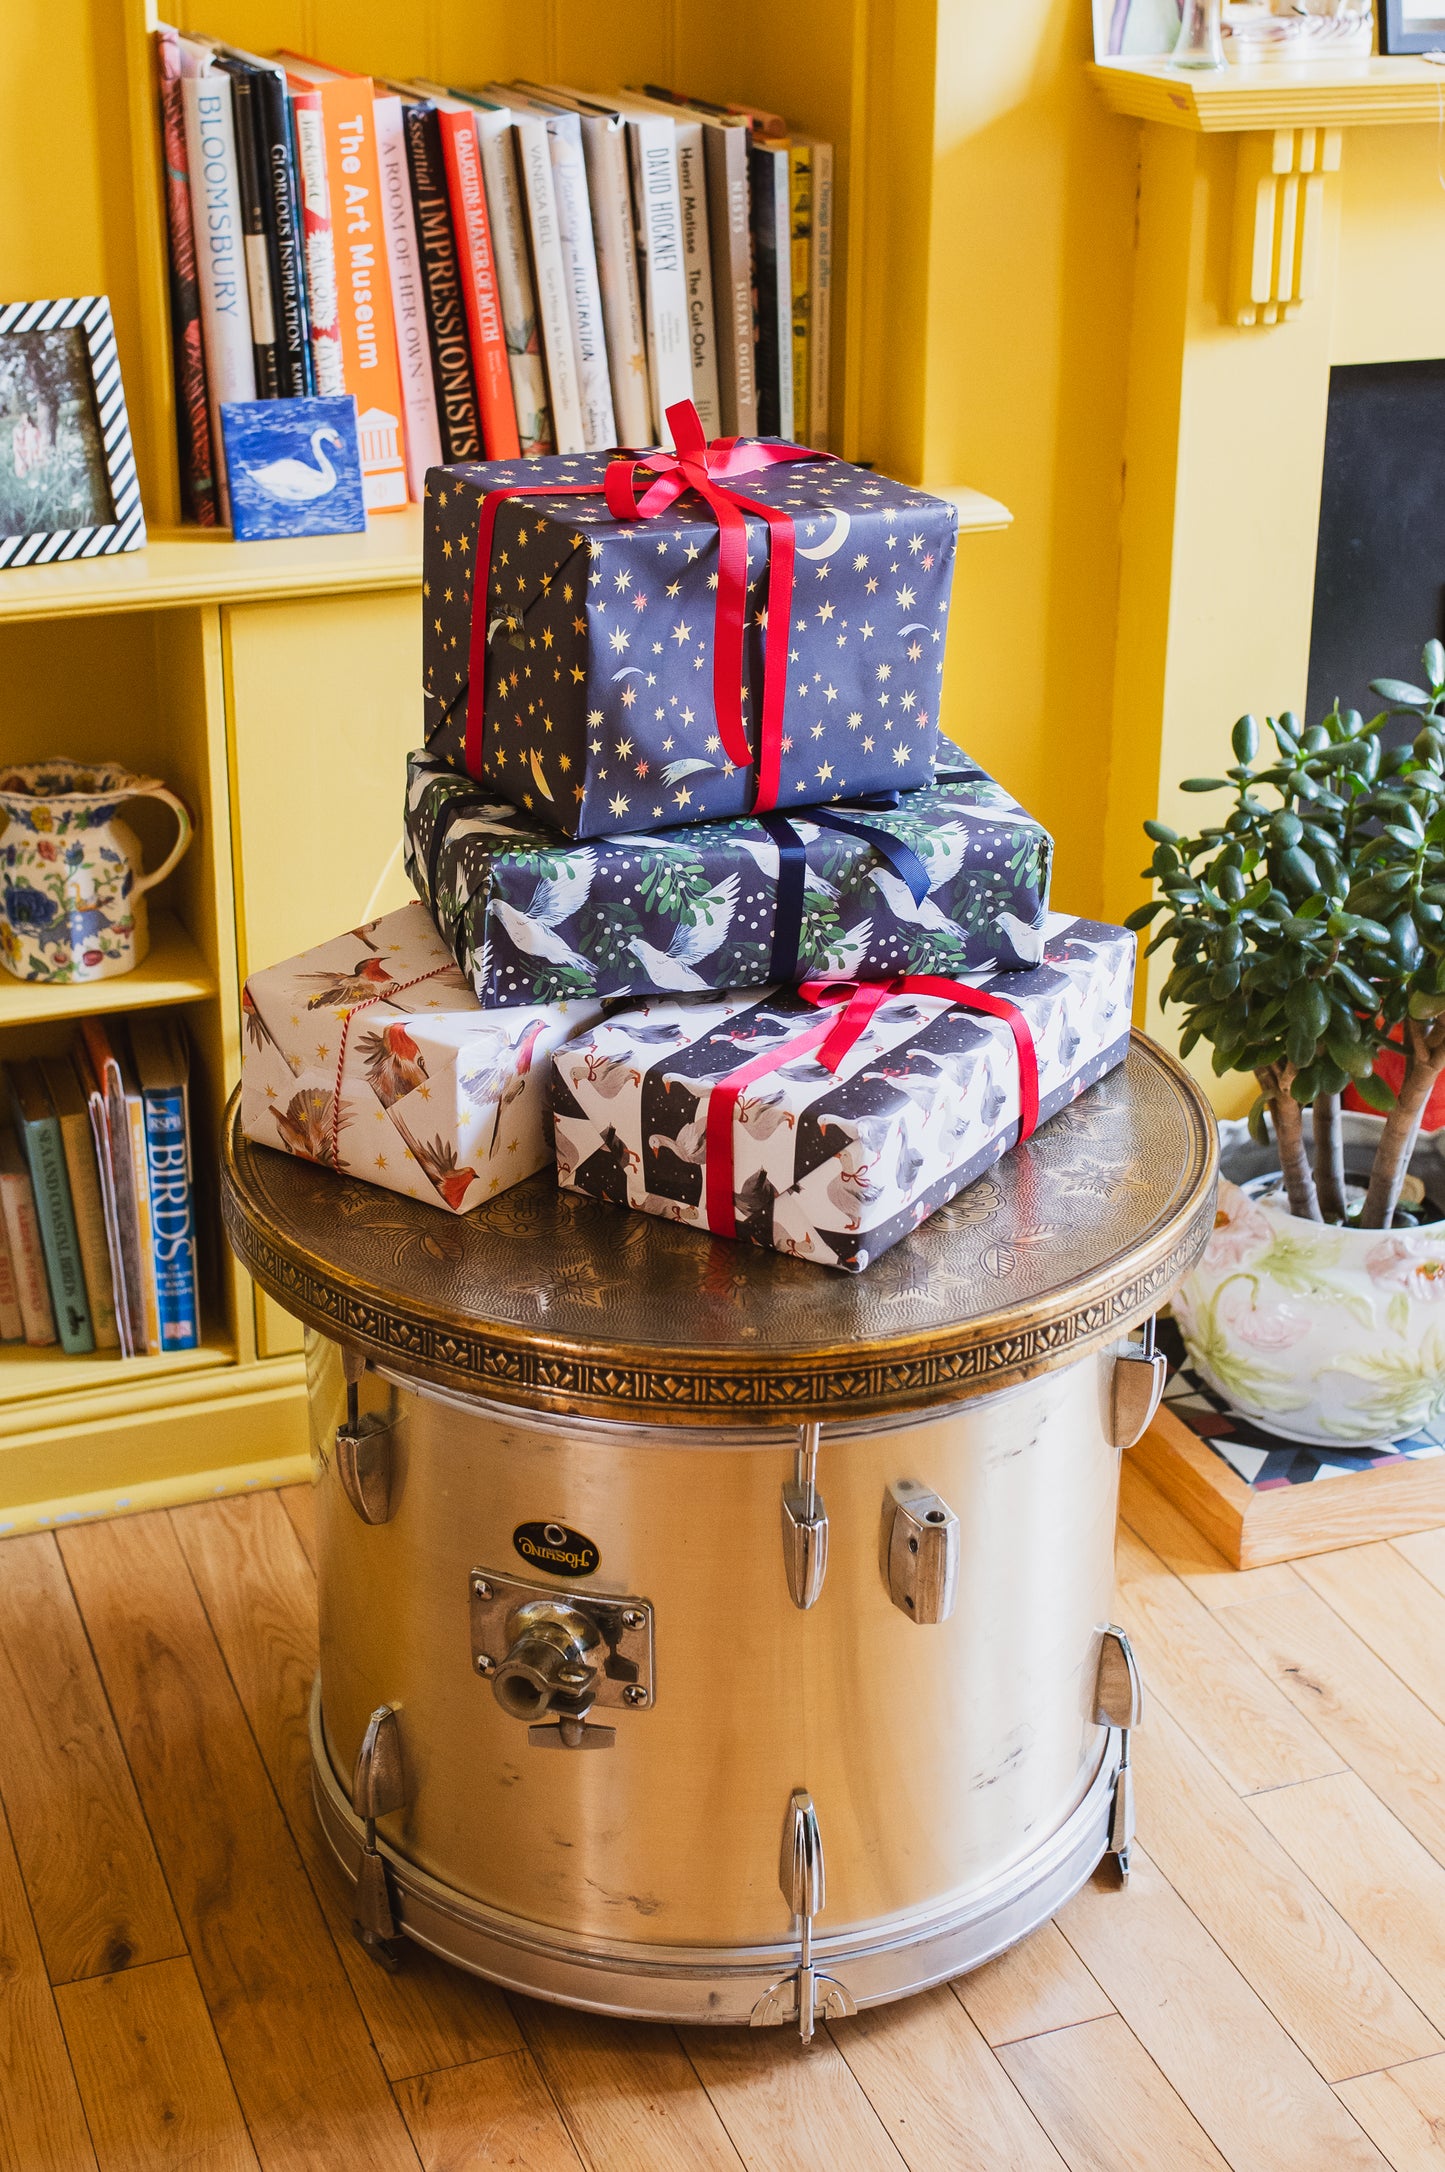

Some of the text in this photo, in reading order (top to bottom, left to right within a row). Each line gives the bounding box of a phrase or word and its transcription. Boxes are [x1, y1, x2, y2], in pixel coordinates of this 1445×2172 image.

[271, 144, 291, 236] GLORIOUS
[383, 142, 397, 155] A
[198, 96, 238, 317] BLOOMSBURY
[385, 162, 406, 231] ROOM
[531, 145, 553, 247] VANESSA BELL
[647, 148, 678, 272] DAVID HOCKNEY
[310, 240, 329, 320] RAUCOUS
[338, 114, 378, 369] The Art Museum
[395, 237, 411, 265] OF
[407, 110, 480, 458] Essential IMPRESSIONISTS
[466, 209, 489, 273] MAKER
[475, 273, 493, 289] OF
[680, 147, 706, 368] Henri Matisse The Cut-Outs
[279, 240, 301, 351] INSPIRATION
[398, 274, 416, 320] HER
[478, 292, 500, 344] MYTH
[572, 267, 595, 362] ILLUSTRATION
[731, 180, 750, 406] NESTS SUSAN OGILVY
[405, 327, 424, 379] OWN
[44, 1159, 60, 1190] AND
[148, 1141, 193, 1262] BIRDS
[518, 1536, 594, 1569] HOSHINO
